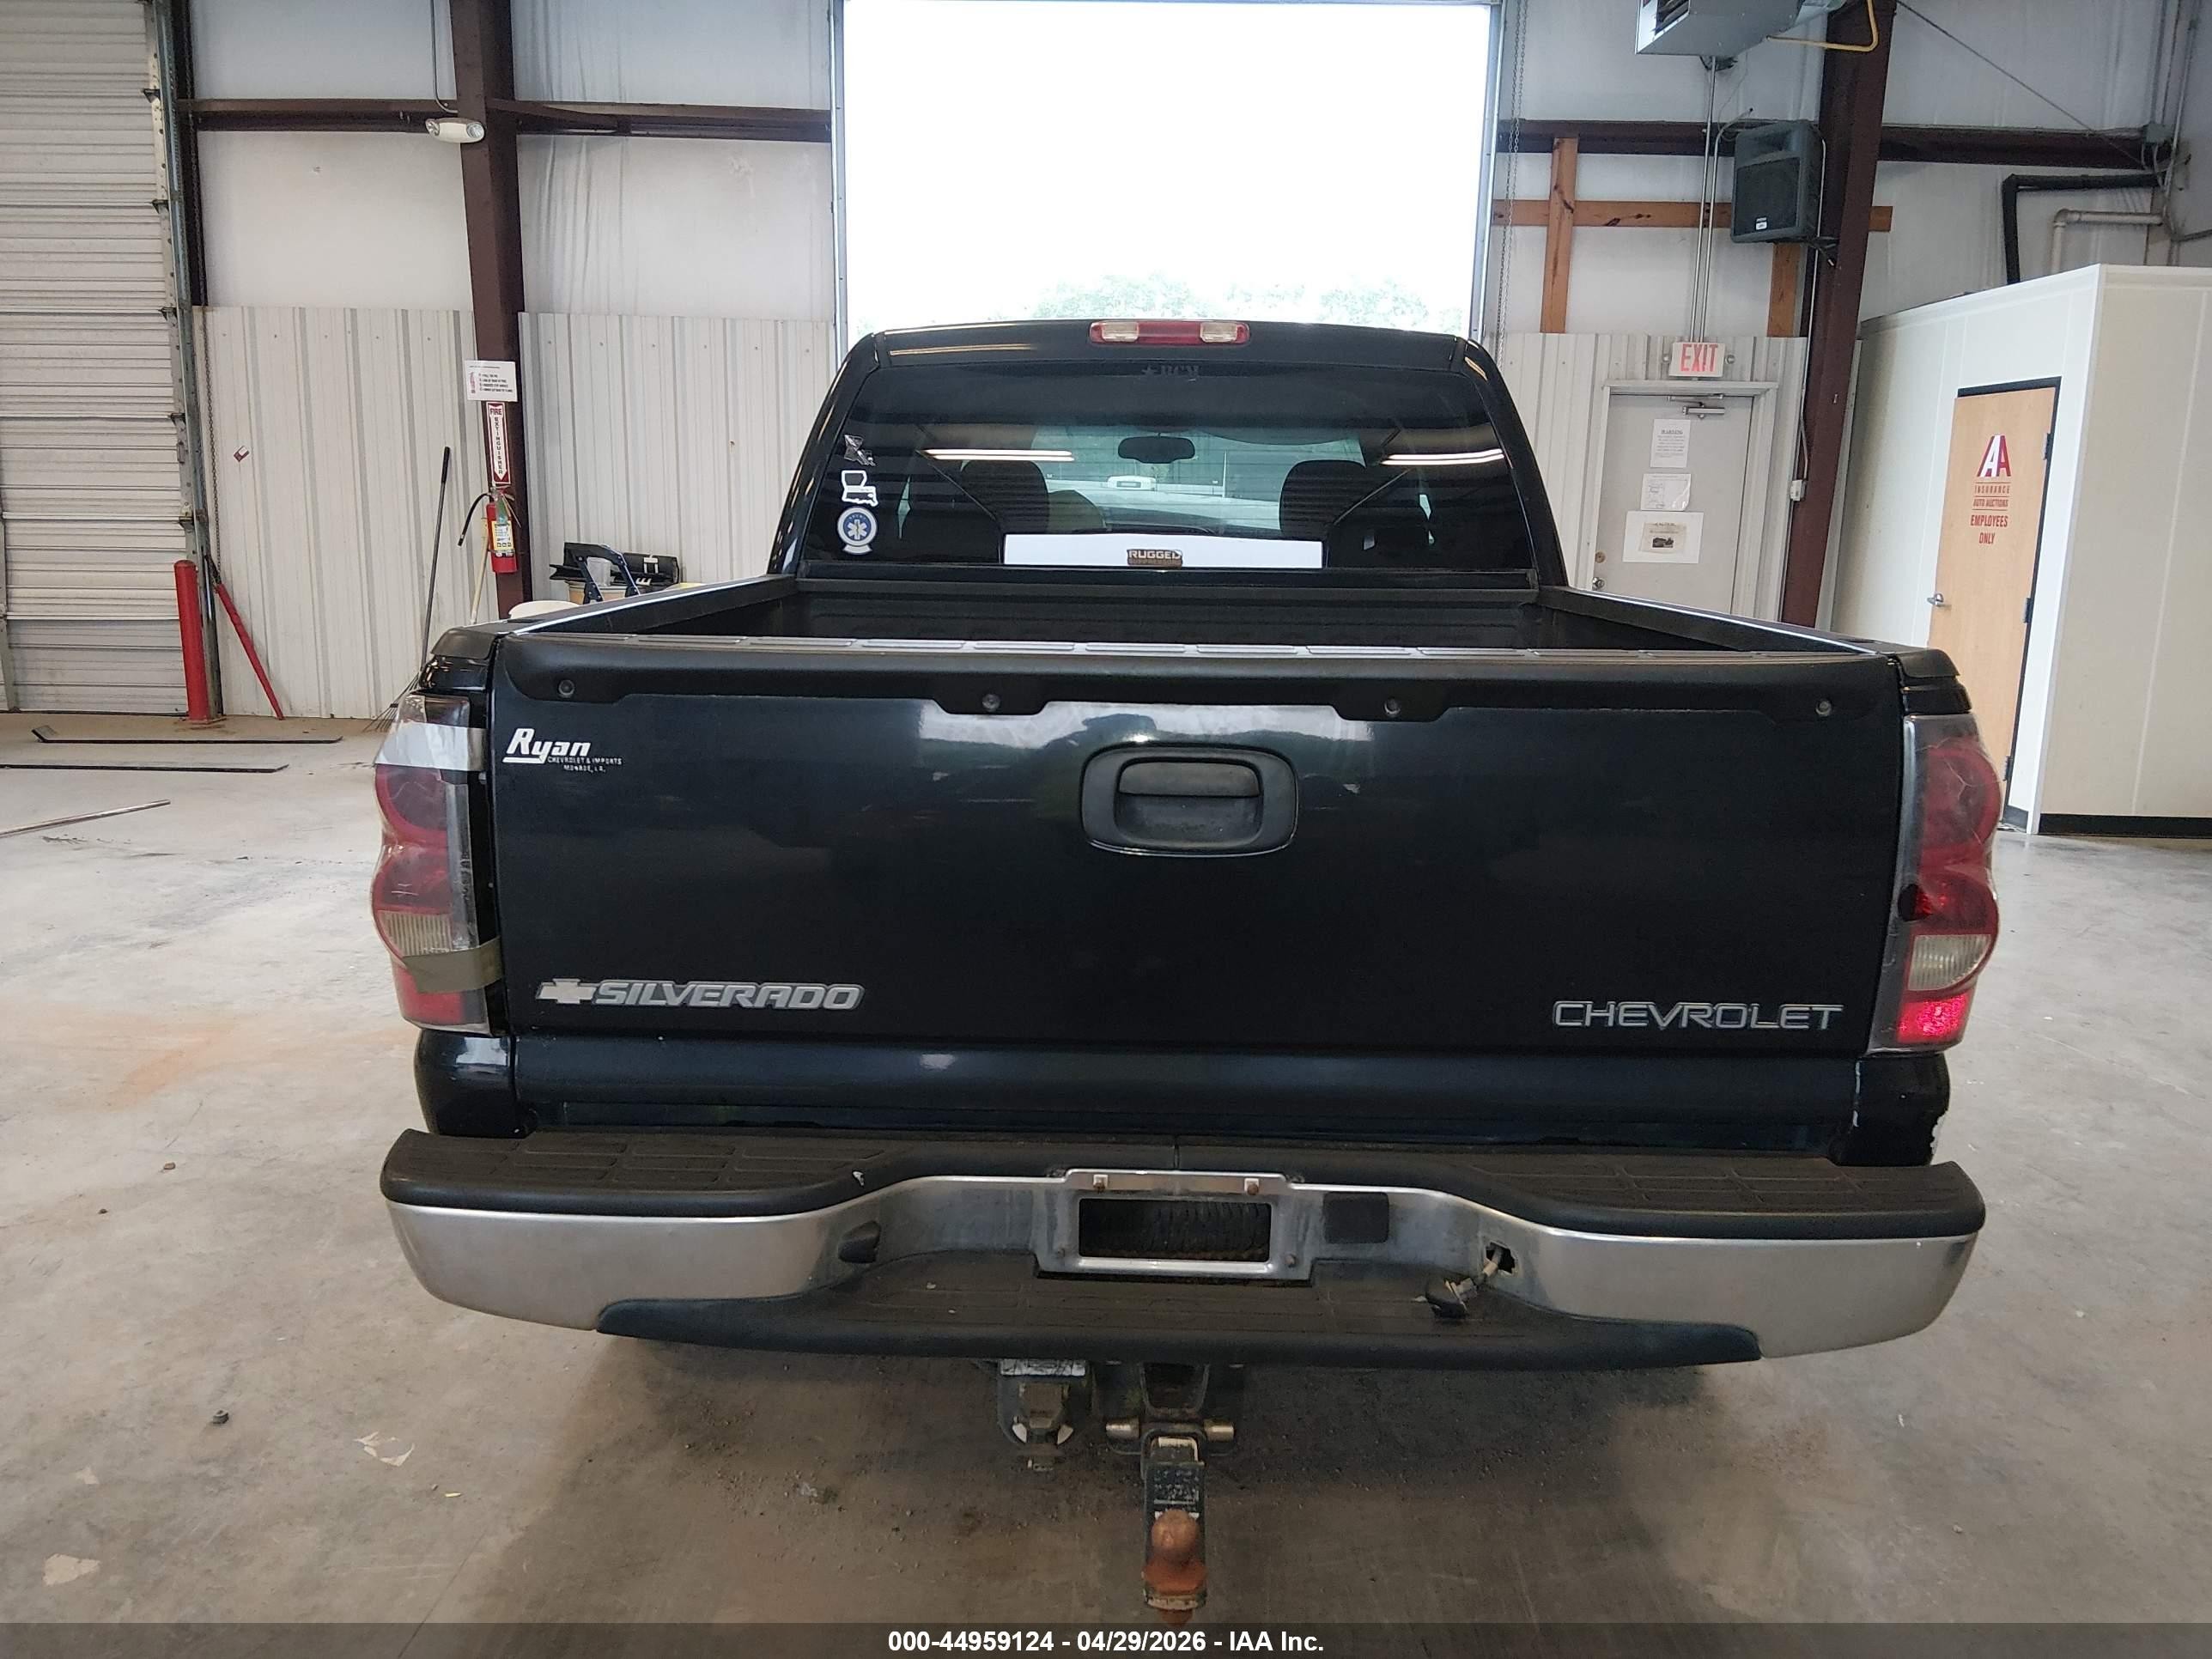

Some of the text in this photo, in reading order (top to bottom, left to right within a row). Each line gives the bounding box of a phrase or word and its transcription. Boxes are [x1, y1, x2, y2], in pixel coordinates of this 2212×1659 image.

[1680, 343, 1717, 372] EXIT
[494, 416, 503, 474] EXTINGUISHER
[1974, 485, 2011, 494] INSURANCE
[1986, 499, 2008, 507] AUCTIONS
[1970, 514, 2008, 528] EMPLOYEES
[1978, 532, 1996, 544] ONLY
[1128, 550, 1181, 559] RUGGED
[504, 728, 592, 764] Ryan
[595, 980, 866, 1009] SILVERADO
[1553, 1000, 1844, 1030] CHEVROLET
